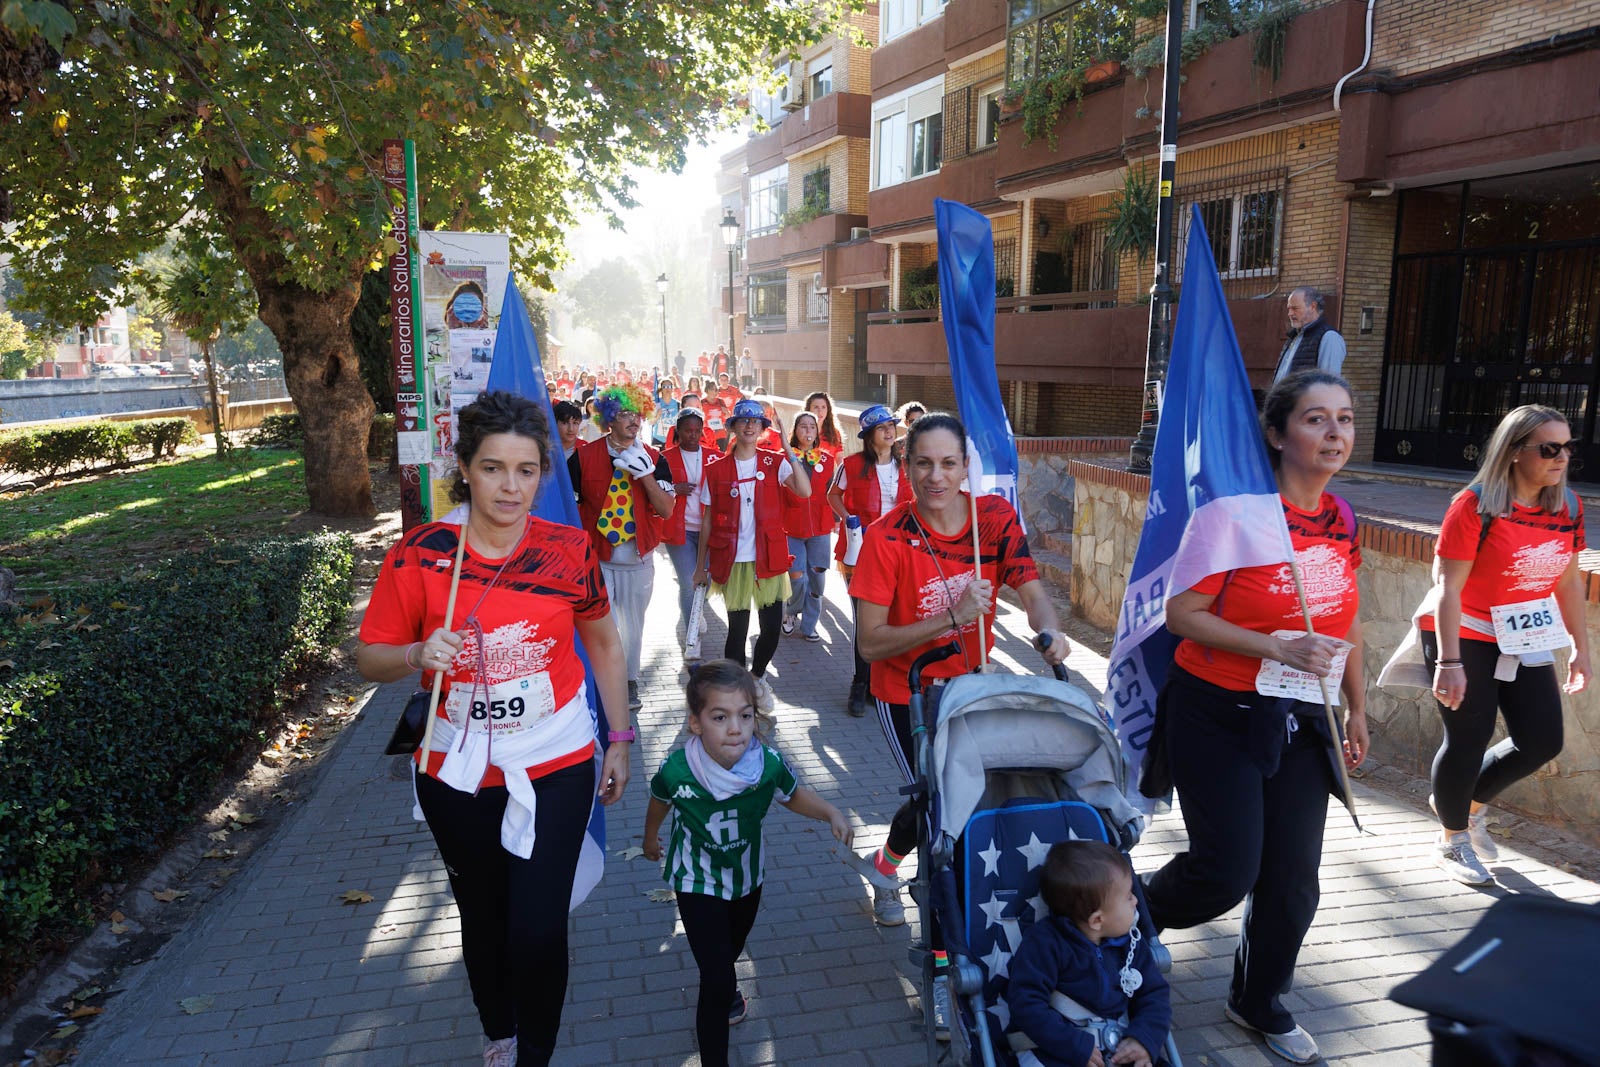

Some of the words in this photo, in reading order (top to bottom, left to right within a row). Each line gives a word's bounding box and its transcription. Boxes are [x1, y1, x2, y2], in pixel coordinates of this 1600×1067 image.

[1528, 221, 1539, 238] 2
[392, 201, 409, 292] Saluable
[1281, 579, 1349, 594] crzroja.es
[1506, 610, 1553, 630] 1285
[471, 696, 525, 720] 859
[483, 721, 521, 730] VRONICA
[704, 839, 748, 852] nework
